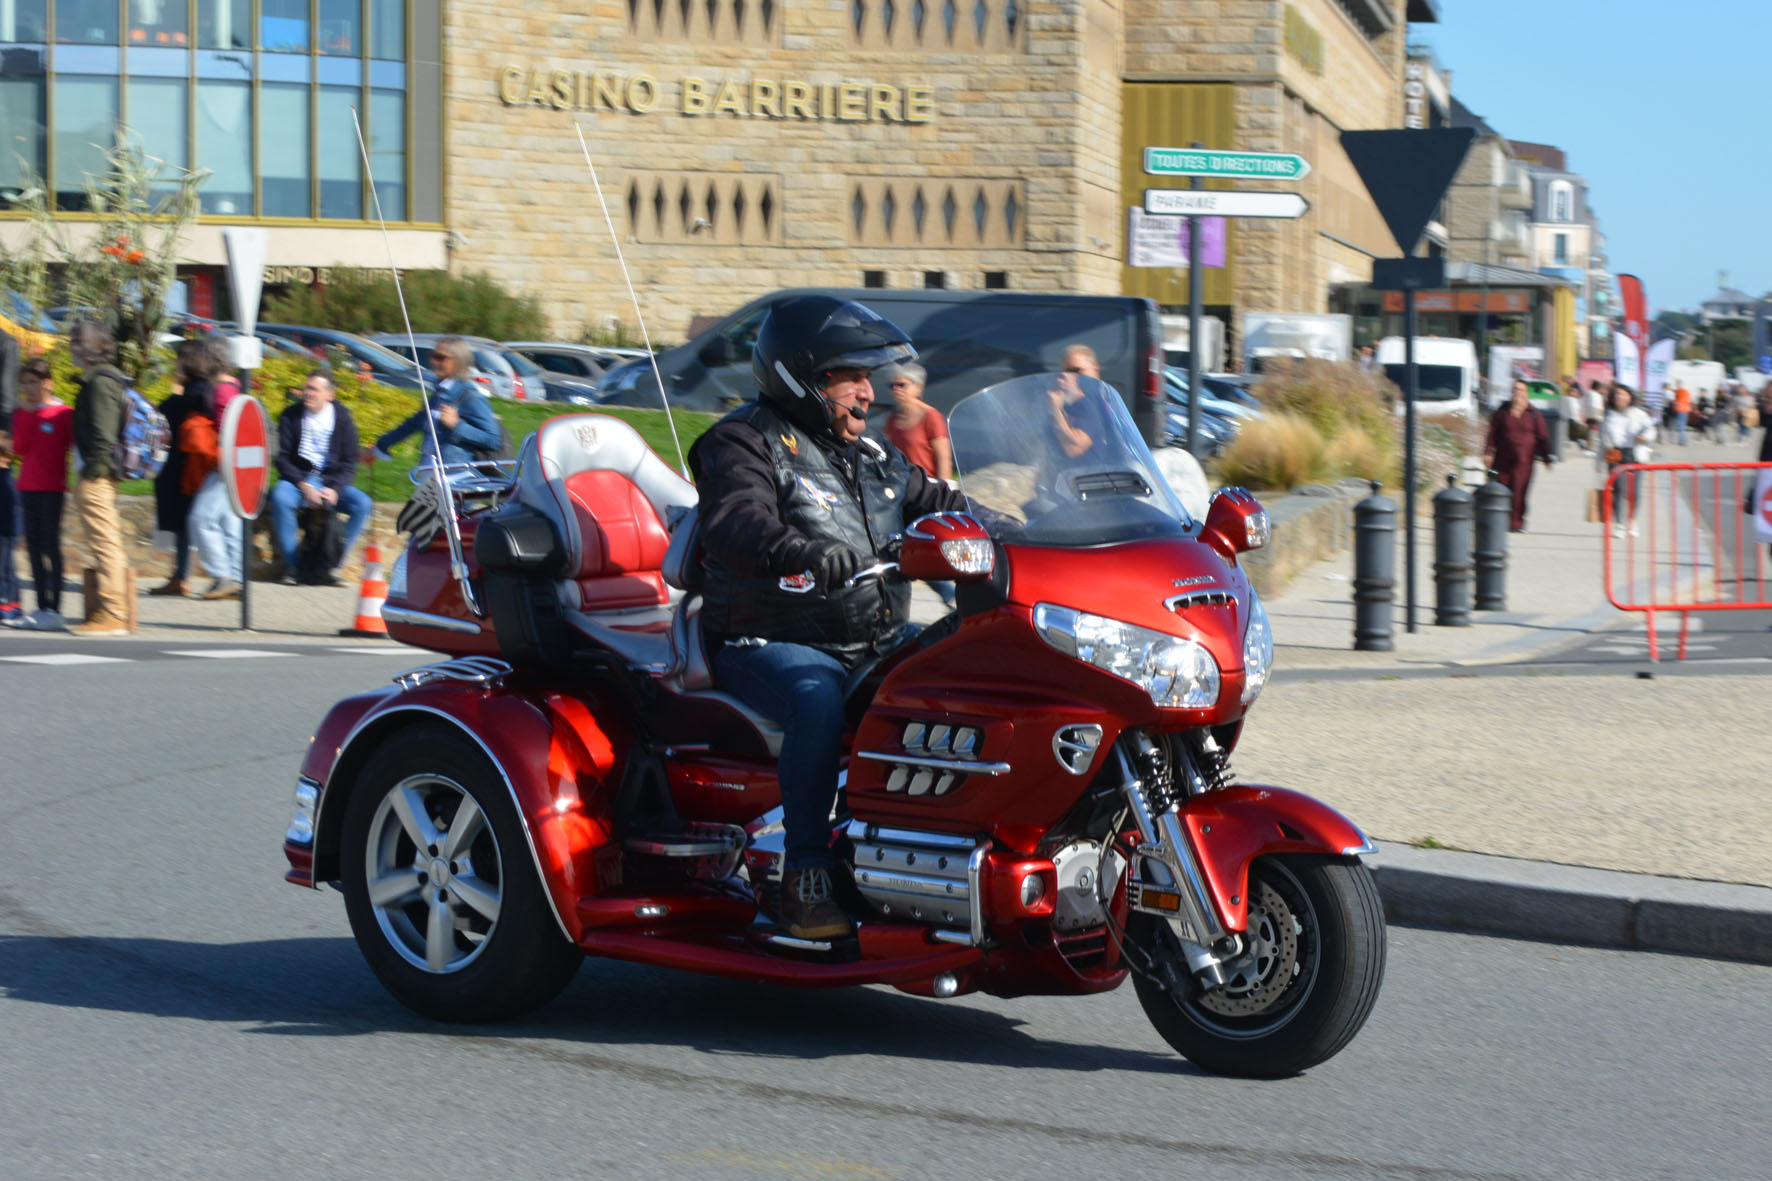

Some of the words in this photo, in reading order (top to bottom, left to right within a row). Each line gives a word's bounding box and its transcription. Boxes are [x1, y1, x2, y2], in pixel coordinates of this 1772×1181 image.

[500, 64, 659, 114] CASINO
[1153, 153, 1208, 170] TOUTES
[1209, 155, 1297, 174] DIRECTIONS
[263, 265, 315, 285] SINO
[1172, 576, 1217, 588] HONDA
[888, 877, 924, 889] HONDA
